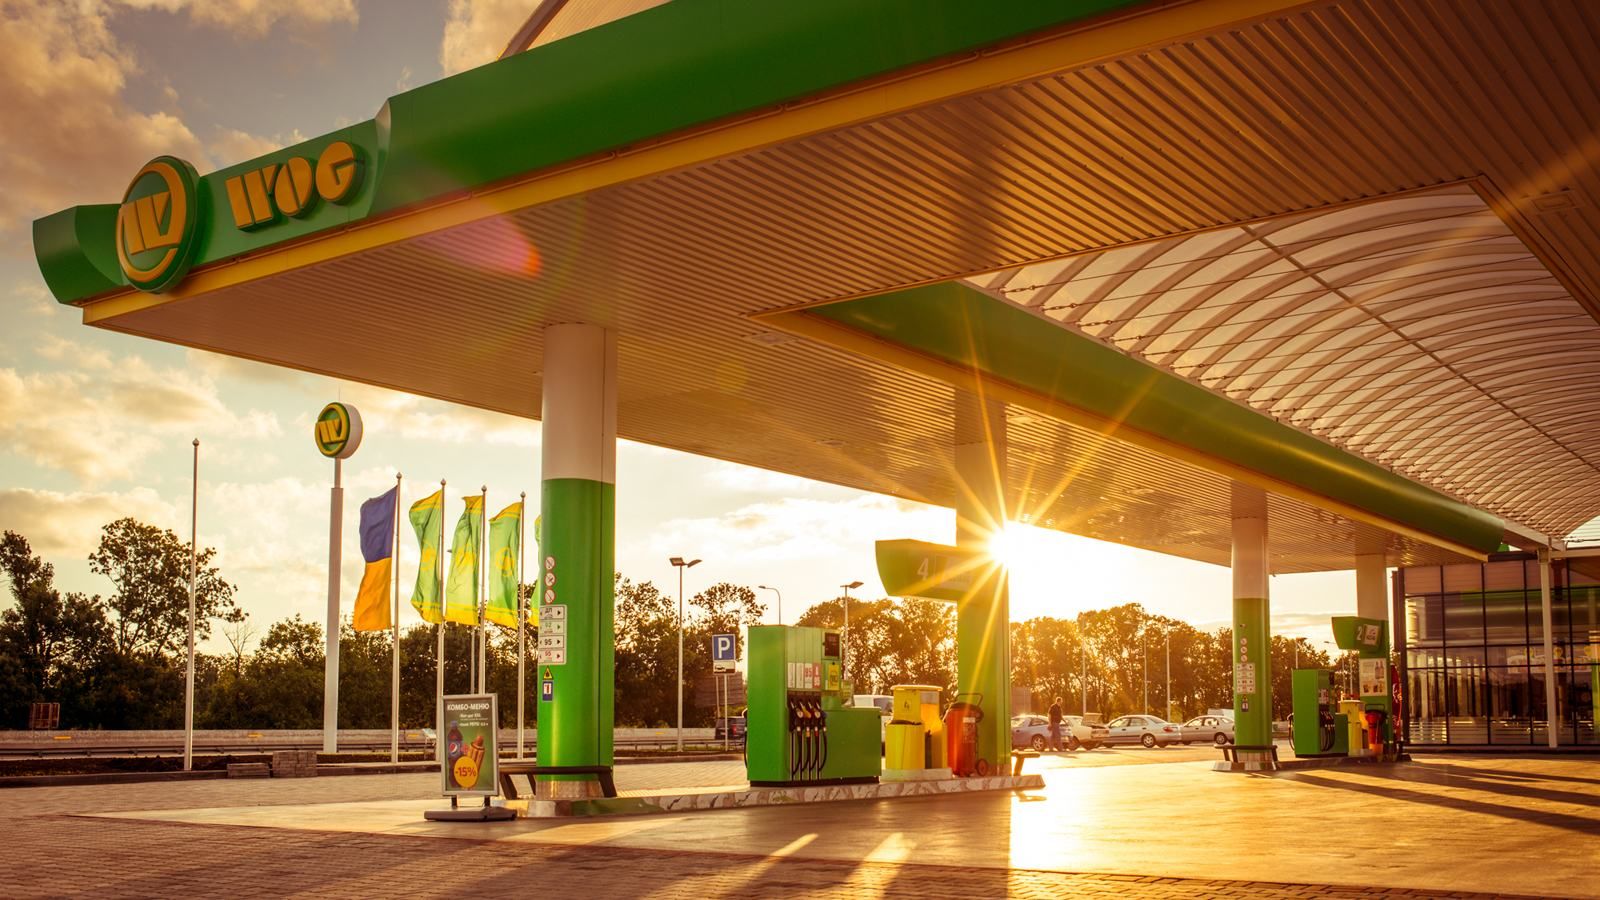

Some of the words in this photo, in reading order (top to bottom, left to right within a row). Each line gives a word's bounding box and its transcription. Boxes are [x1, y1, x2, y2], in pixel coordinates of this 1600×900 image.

[916, 557, 929, 581] 4
[1356, 626, 1363, 641] 2
[544, 638, 553, 646] 95
[718, 637, 731, 659] P
[447, 703, 490, 711] КОМБО-МЕНЮ
[455, 766, 476, 777] -15%
